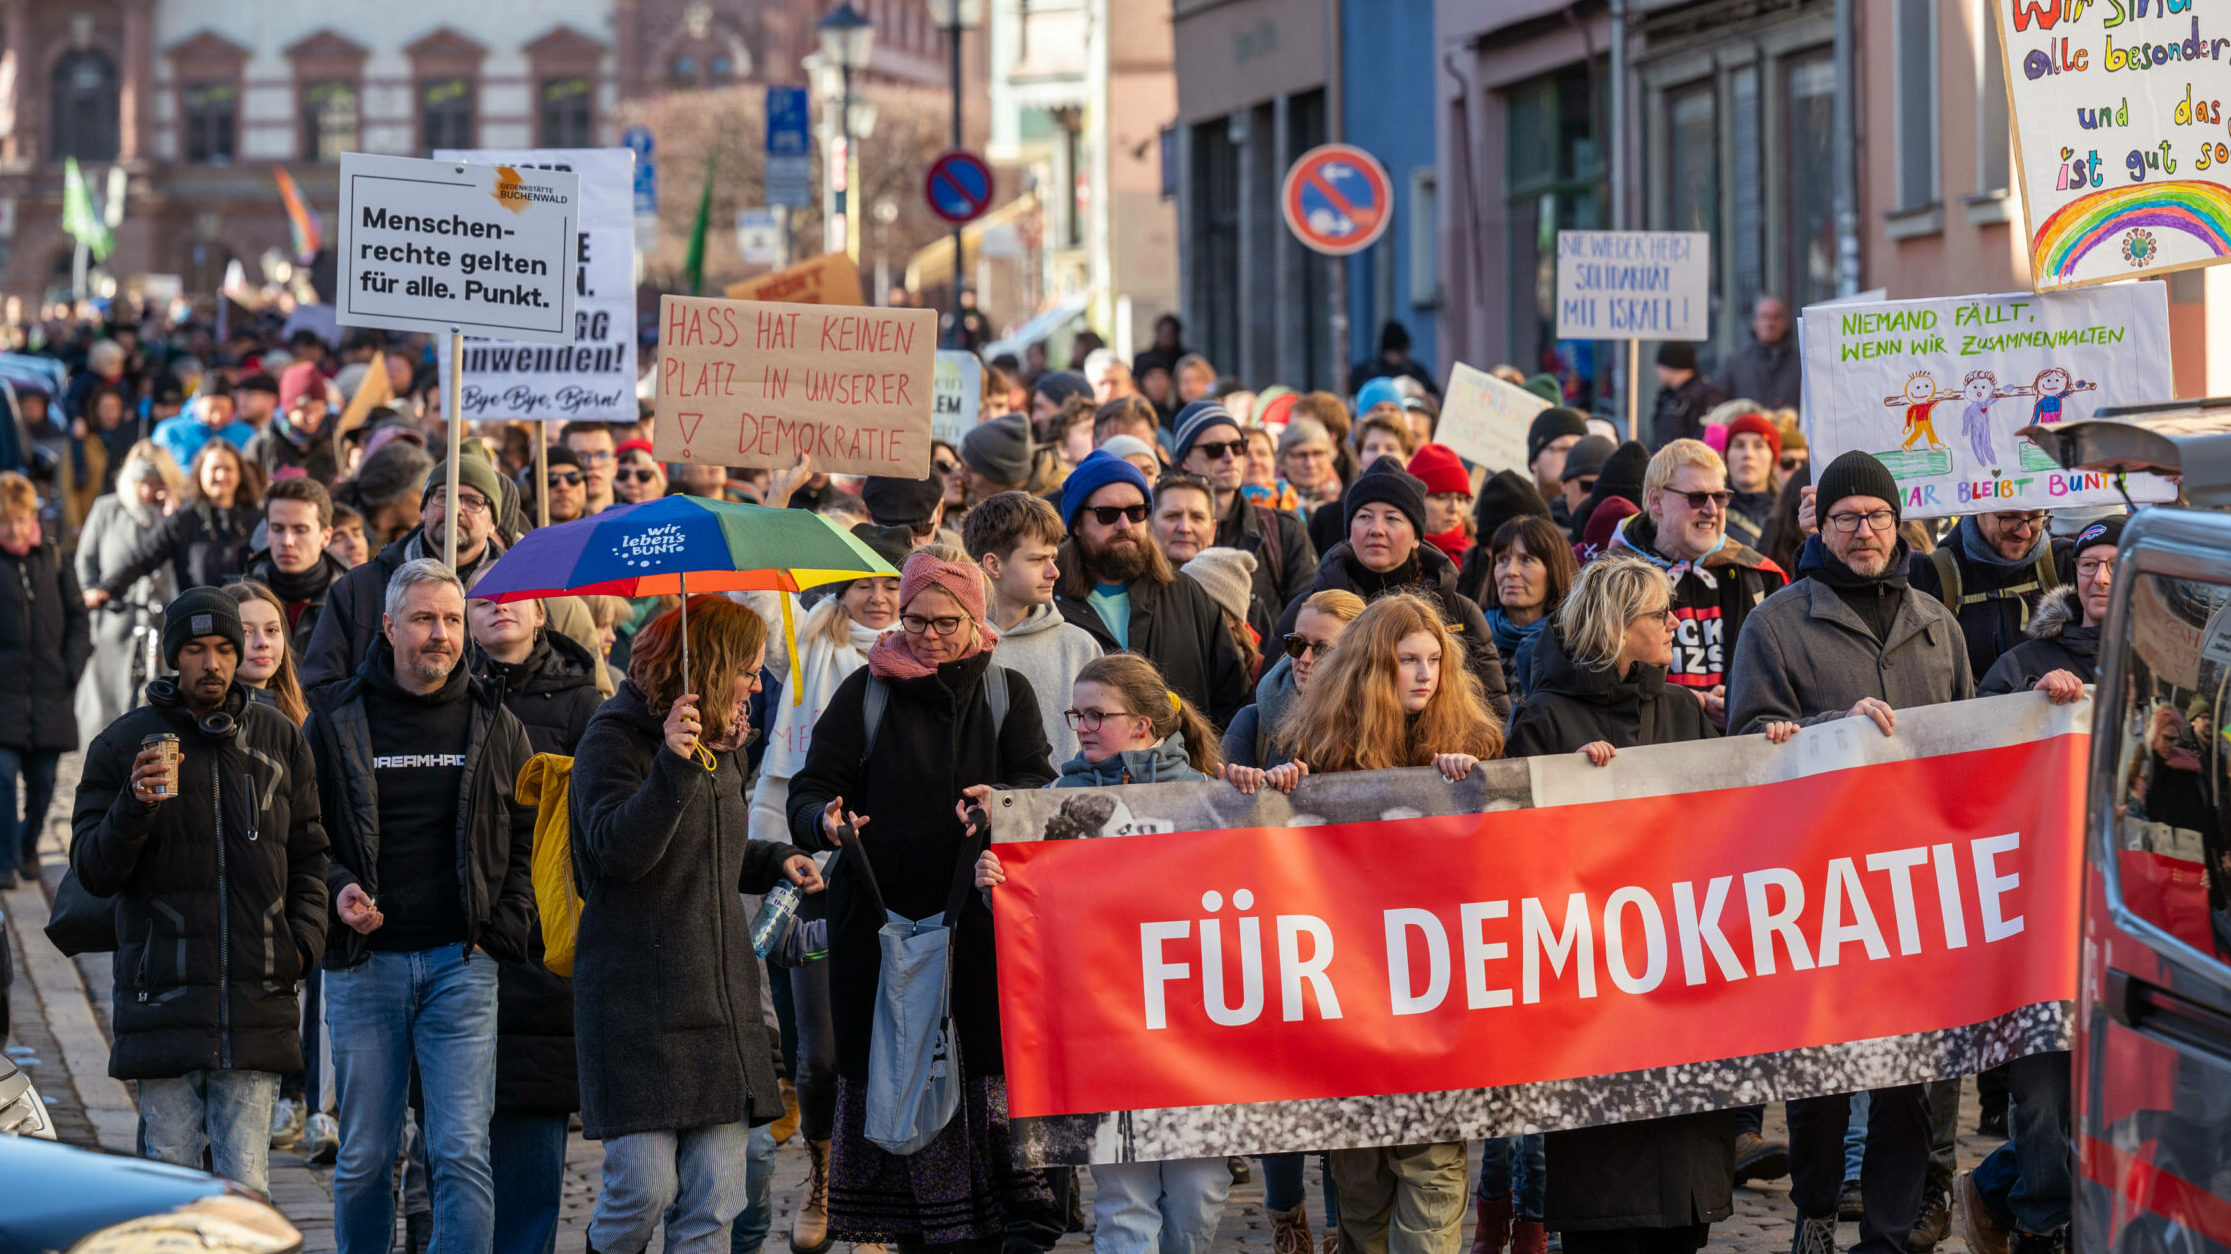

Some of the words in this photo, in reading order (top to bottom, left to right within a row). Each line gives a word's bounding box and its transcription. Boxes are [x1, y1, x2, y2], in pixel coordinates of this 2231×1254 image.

[2024, 36, 2089, 80] alle
[2104, 15, 2231, 72] besonder
[2077, 97, 2128, 129] und
[2174, 83, 2220, 126] das
[2056, 146, 2103, 191] ist
[2126, 139, 2176, 182] gut
[2195, 142, 2229, 171] so
[500, 183, 553, 194] GEDENKSTÄTTE
[500, 190, 568, 204] BUCHENWALD
[362, 206, 515, 240] Menschen-
[360, 243, 451, 267] rechte
[460, 251, 547, 276] gelten
[360, 270, 399, 293] für
[405, 276, 455, 300] alle.
[465, 280, 550, 308] Punkt.
[668, 303, 739, 347] HASS
[757, 310, 801, 349] HAT
[820, 314, 914, 355] KEINEN
[1841, 309, 1938, 336] NIEMAND
[1841, 340, 1902, 362] WENN
[1960, 326, 2125, 357] ZUSAMMENHALTEN
[665, 357, 736, 397] PLATZ
[763, 364, 789, 400] IN
[805, 368, 912, 406] UNSERER
[738, 412, 905, 462] DEMOKRATIE
[647, 523, 682, 536] wir
[1672, 617, 1724, 647] CK
[1140, 888, 1343, 1030] FÜR
[1383, 831, 2024, 1018] DEMOKRATIE
